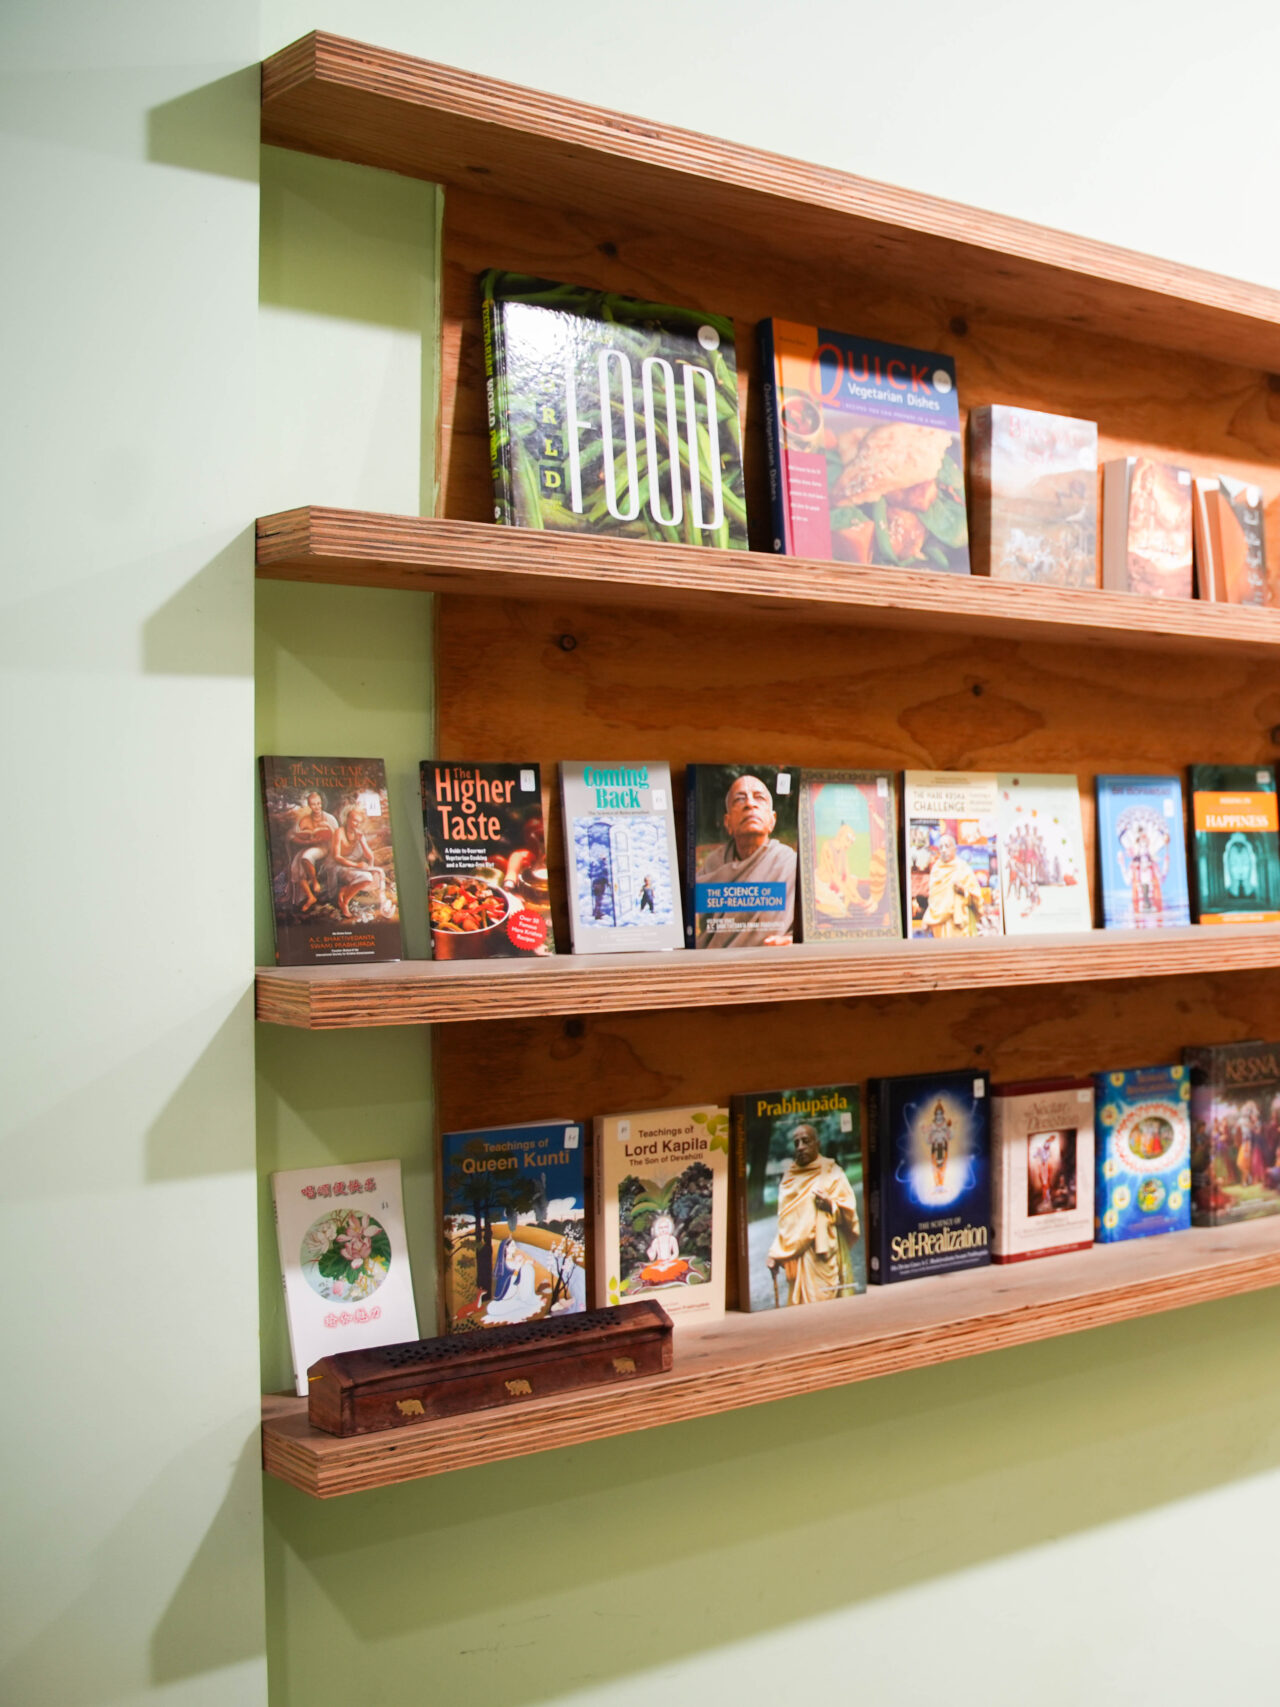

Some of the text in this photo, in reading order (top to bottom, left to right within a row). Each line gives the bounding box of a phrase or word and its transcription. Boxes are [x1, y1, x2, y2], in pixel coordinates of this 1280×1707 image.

[808, 343, 932, 407] QUICK
[487, 378, 496, 427] WORLD
[847, 382, 941, 411] Vegetarian Dishes
[566, 348, 724, 531] FOOD
[289, 761, 308, 776] The
[453, 767, 472, 779] The
[583, 765, 650, 789] Coming
[435, 767, 516, 814] Higher
[595, 788, 641, 809] Back
[913, 800, 966, 813] CHALLENGE
[437, 805, 501, 840] Taste
[1205, 814, 1269, 828] HAPPINESS
[707, 886, 772, 897] THE SCIENCE OF
[706, 896, 783, 908] SELF-REALIZATION
[757, 1093, 848, 1118] Prabhupāda
[638, 1125, 694, 1138] Teachings of
[483, 1138, 549, 1152] Teachings of
[625, 1138, 708, 1157] Lord Kapila
[462, 1157, 519, 1174] Queen
[890, 1224, 988, 1262] Self-Realization
